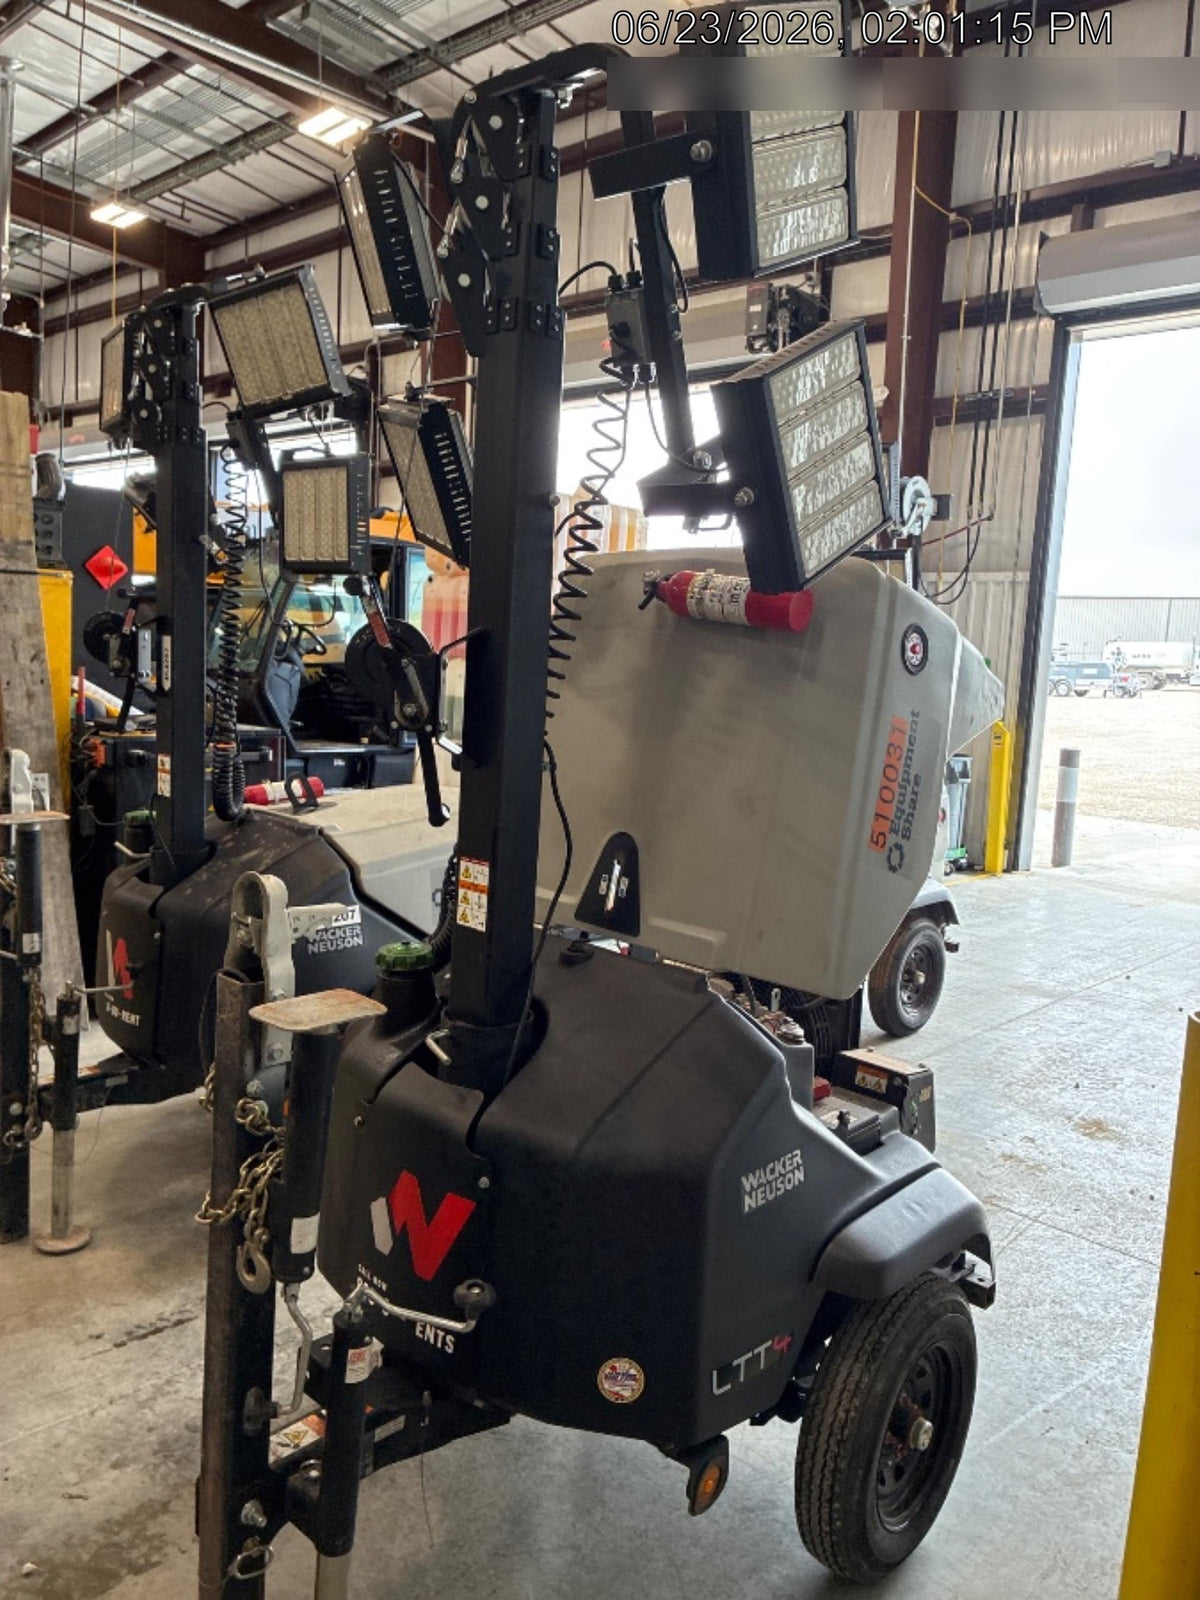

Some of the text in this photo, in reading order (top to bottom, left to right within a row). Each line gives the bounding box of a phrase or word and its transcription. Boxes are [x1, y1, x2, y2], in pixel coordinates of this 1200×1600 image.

[870, 724, 906, 849] 510031
[889, 709, 920, 836] Equipment
[901, 773, 922, 842] Share
[307, 935, 363, 954] NEUSON
[741, 1149, 803, 1193] WACKER
[744, 1166, 805, 1214] NEUSON
[413, 1320, 456, 1354] ENTS
[712, 1334, 793, 1396] LTT4
